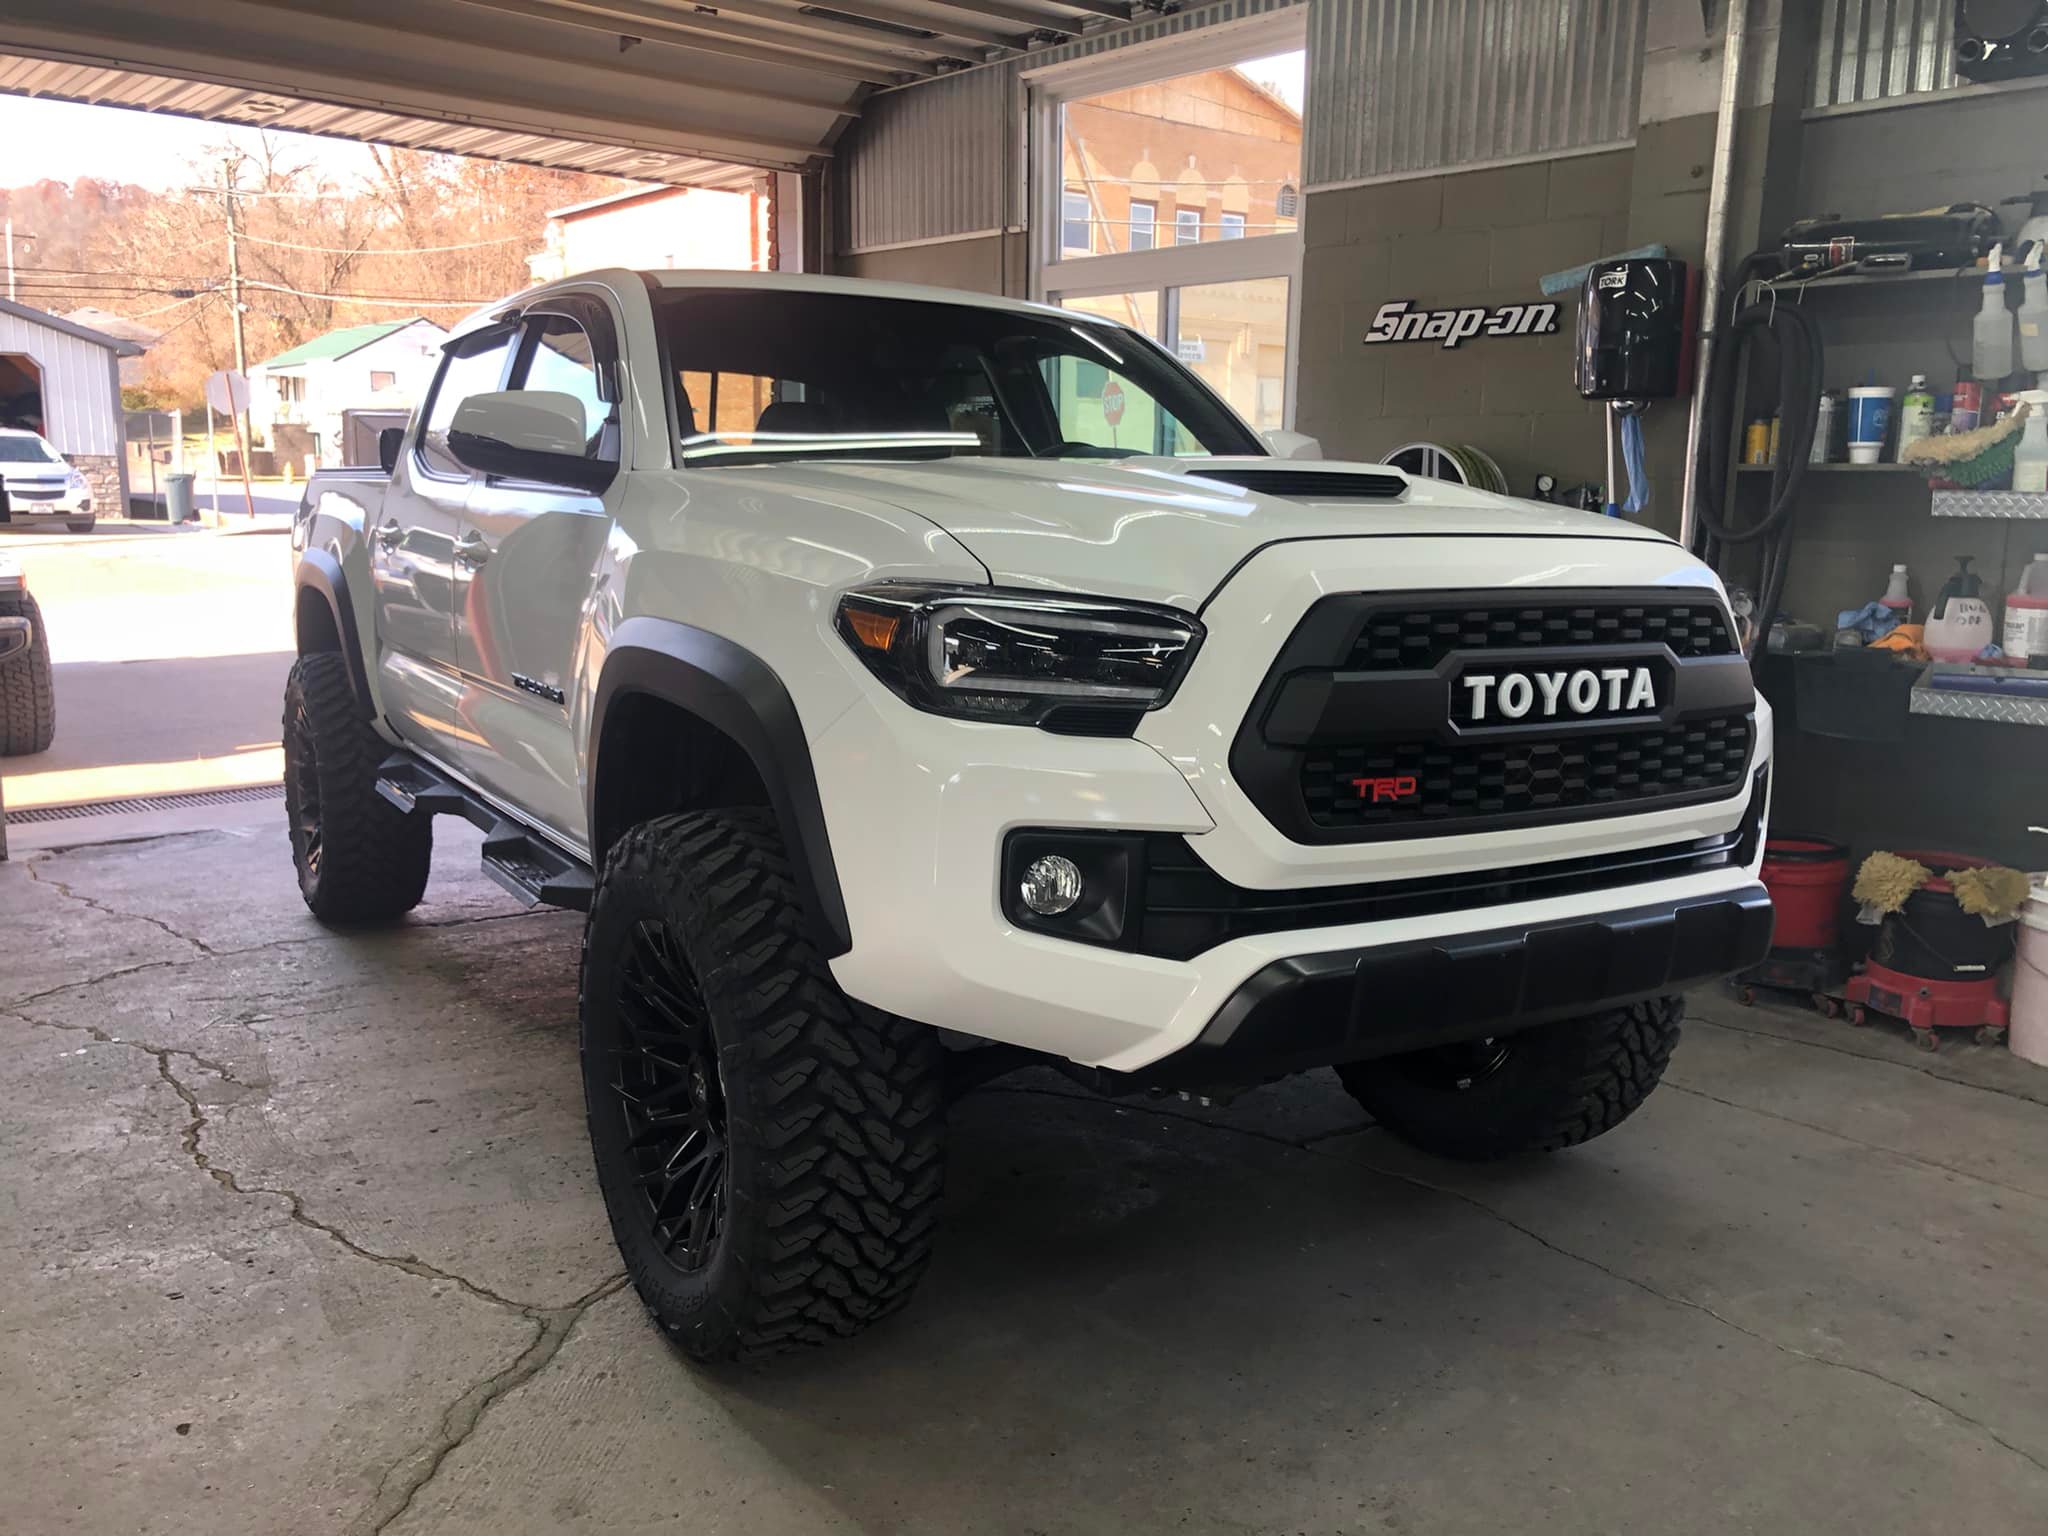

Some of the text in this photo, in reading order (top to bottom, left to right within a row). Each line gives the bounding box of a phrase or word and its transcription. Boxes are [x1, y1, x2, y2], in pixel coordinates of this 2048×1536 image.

[1600, 276, 1625, 287] TORK
[1364, 302, 1555, 347] Snap-on
[1463, 667, 1656, 720] TOYOTA
[1352, 776, 1416, 802] TRD
